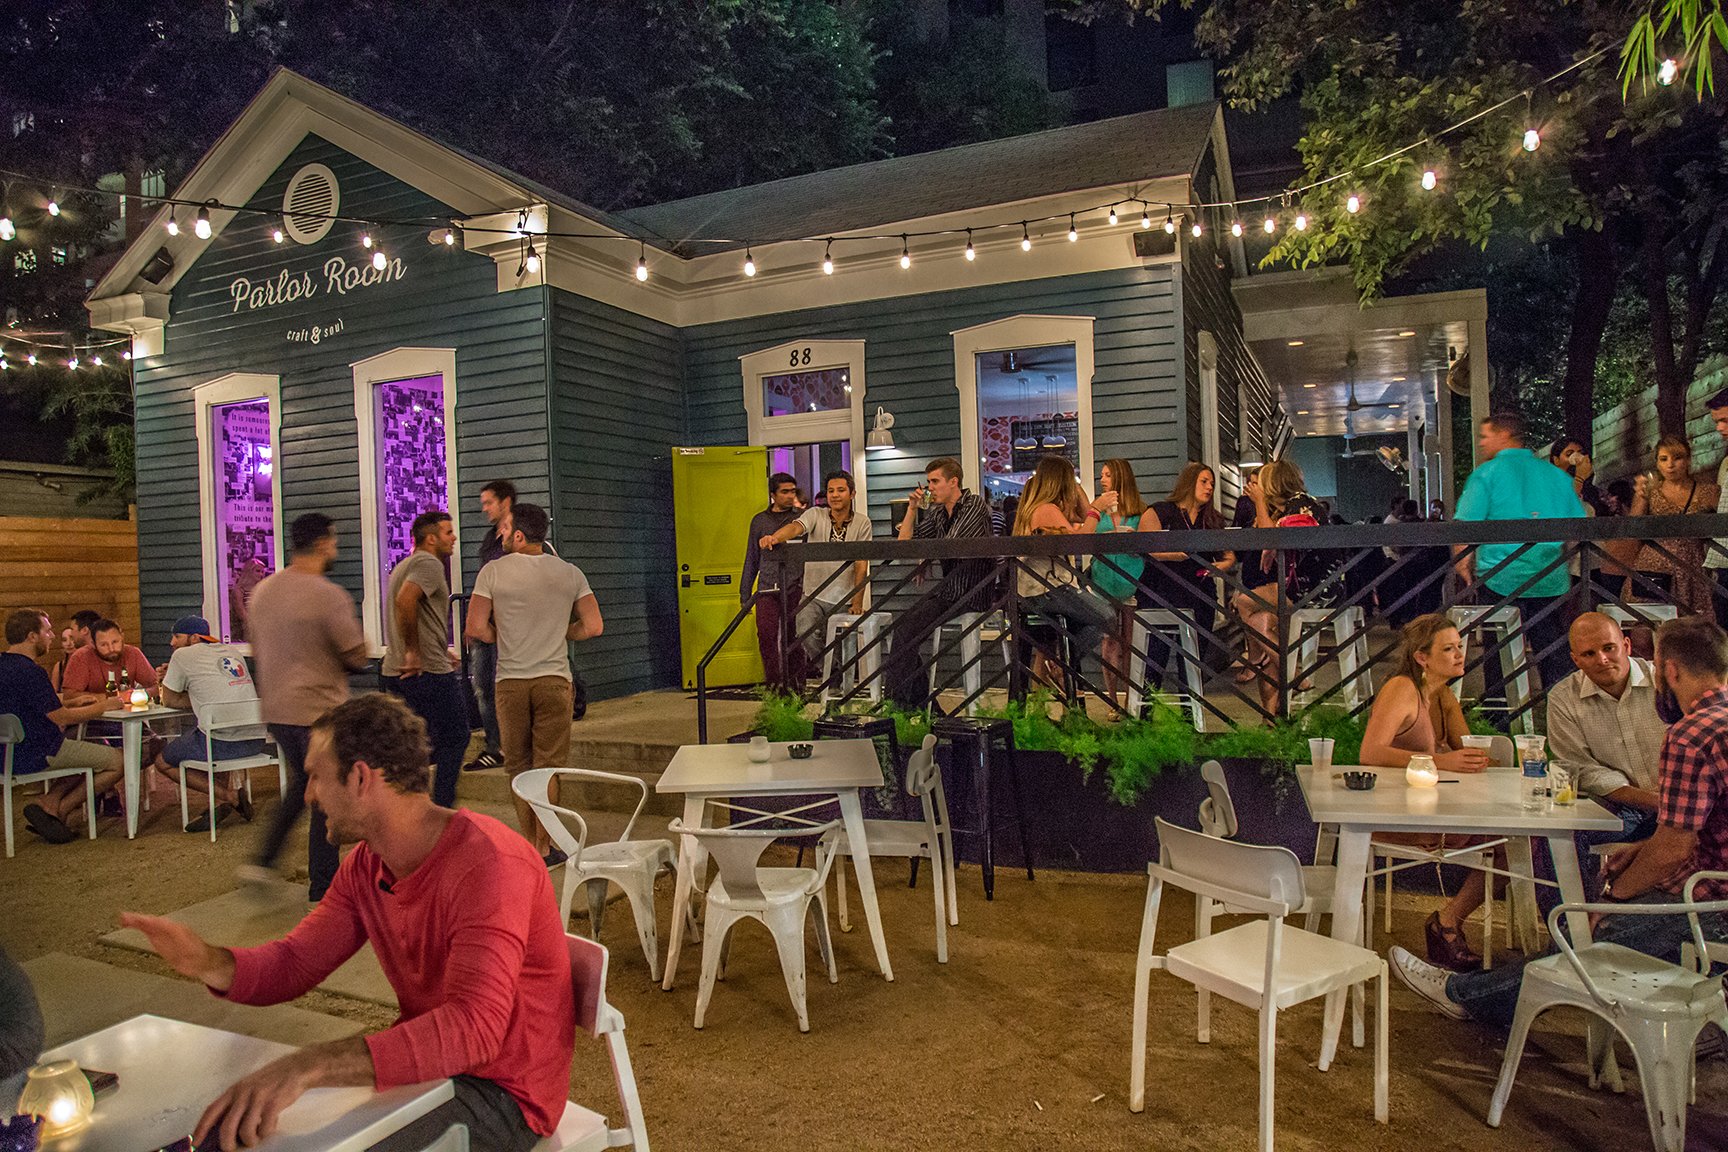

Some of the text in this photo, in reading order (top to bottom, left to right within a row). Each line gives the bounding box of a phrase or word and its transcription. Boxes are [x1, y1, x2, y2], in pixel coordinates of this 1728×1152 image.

[231, 256, 408, 312] Parlor Room
[286, 318, 344, 345] craft & soul
[789, 347, 811, 367] 88
[234, 503, 246, 511] This
[247, 504, 253, 512] is
[234, 514, 253, 522] tribute
[262, 515, 272, 523] the
